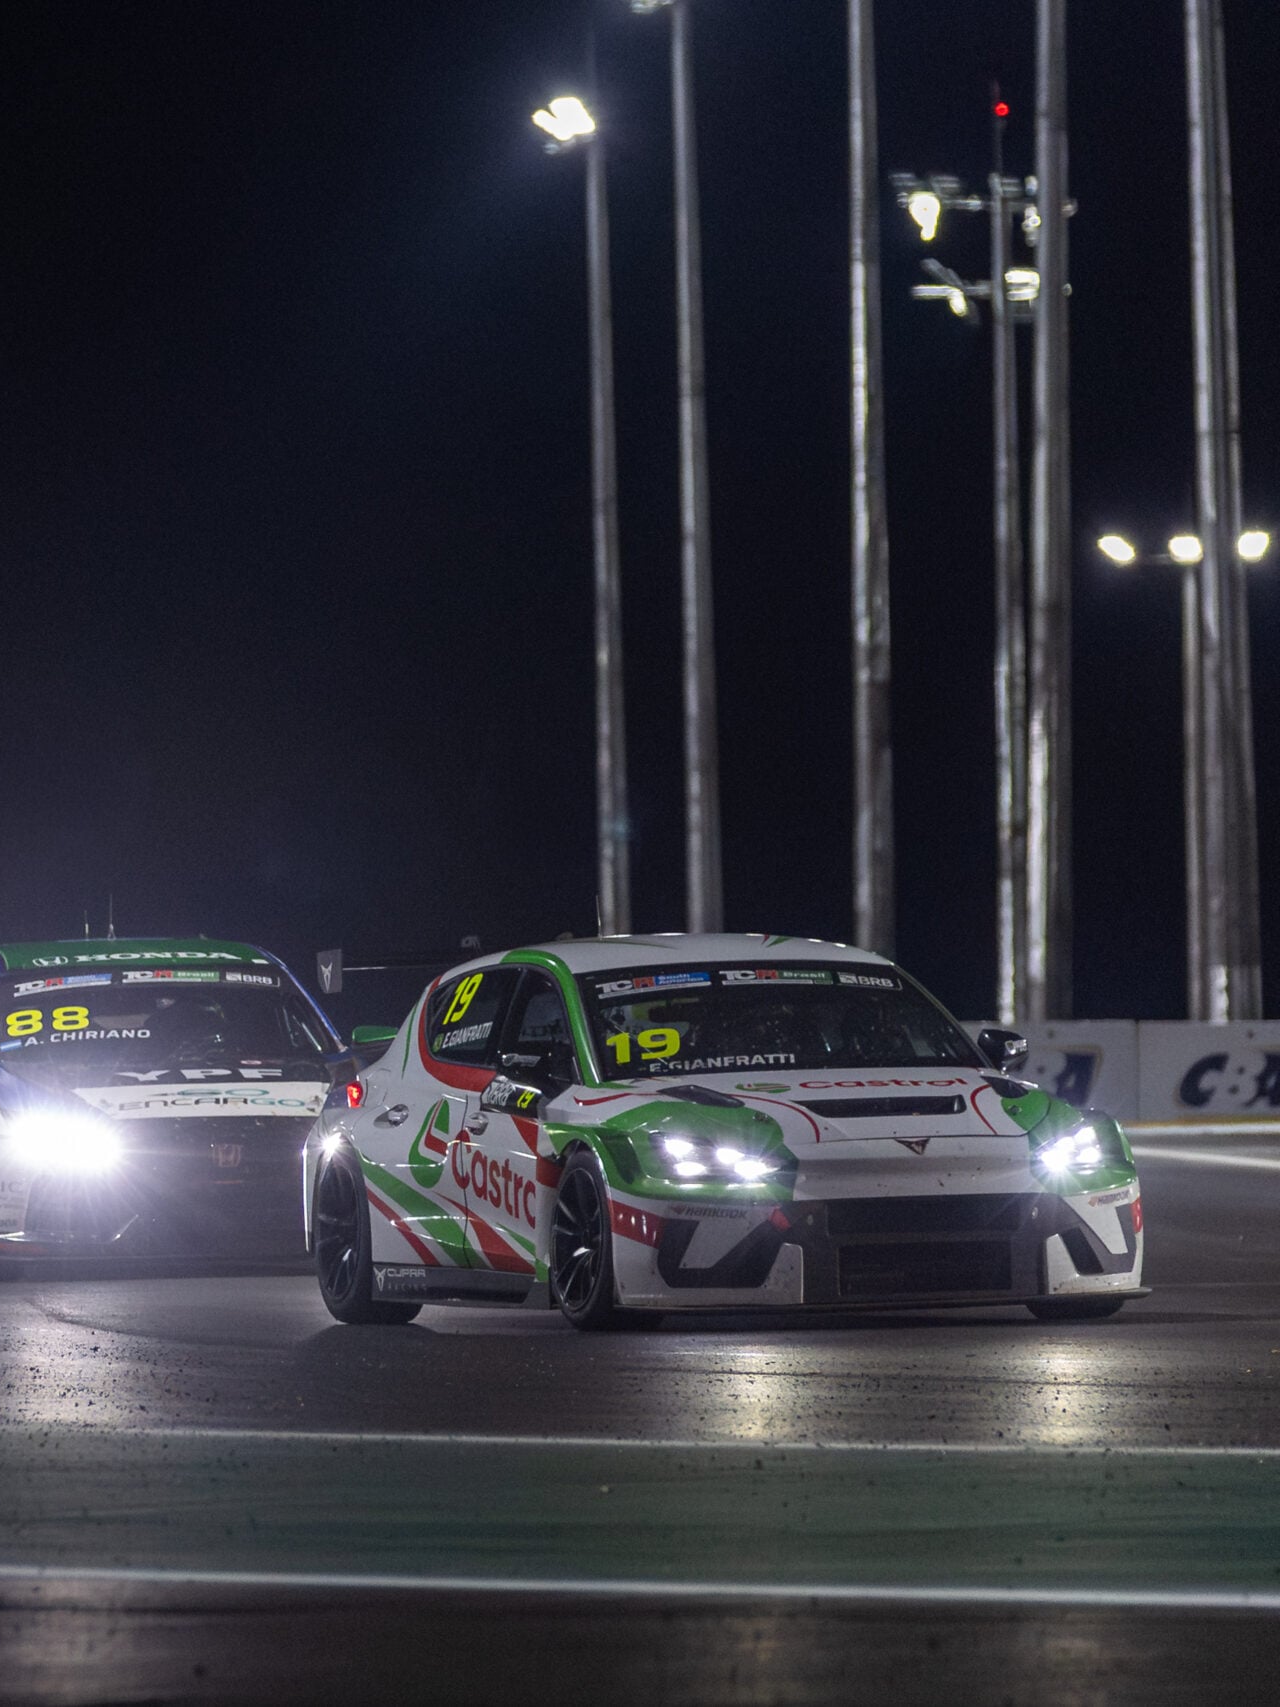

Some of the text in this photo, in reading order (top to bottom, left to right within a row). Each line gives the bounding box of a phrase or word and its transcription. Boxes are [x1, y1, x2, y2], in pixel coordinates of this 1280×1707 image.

[74, 951, 242, 962] HONDA
[858, 975, 894, 987] BRB
[442, 973, 483, 1025] 19
[5, 1006, 89, 1037] 88
[50, 1028, 151, 1043] CHIRIANO
[606, 1027, 681, 1064] 19
[116, 1068, 283, 1081] YPF
[799, 1078, 968, 1089] Castrol
